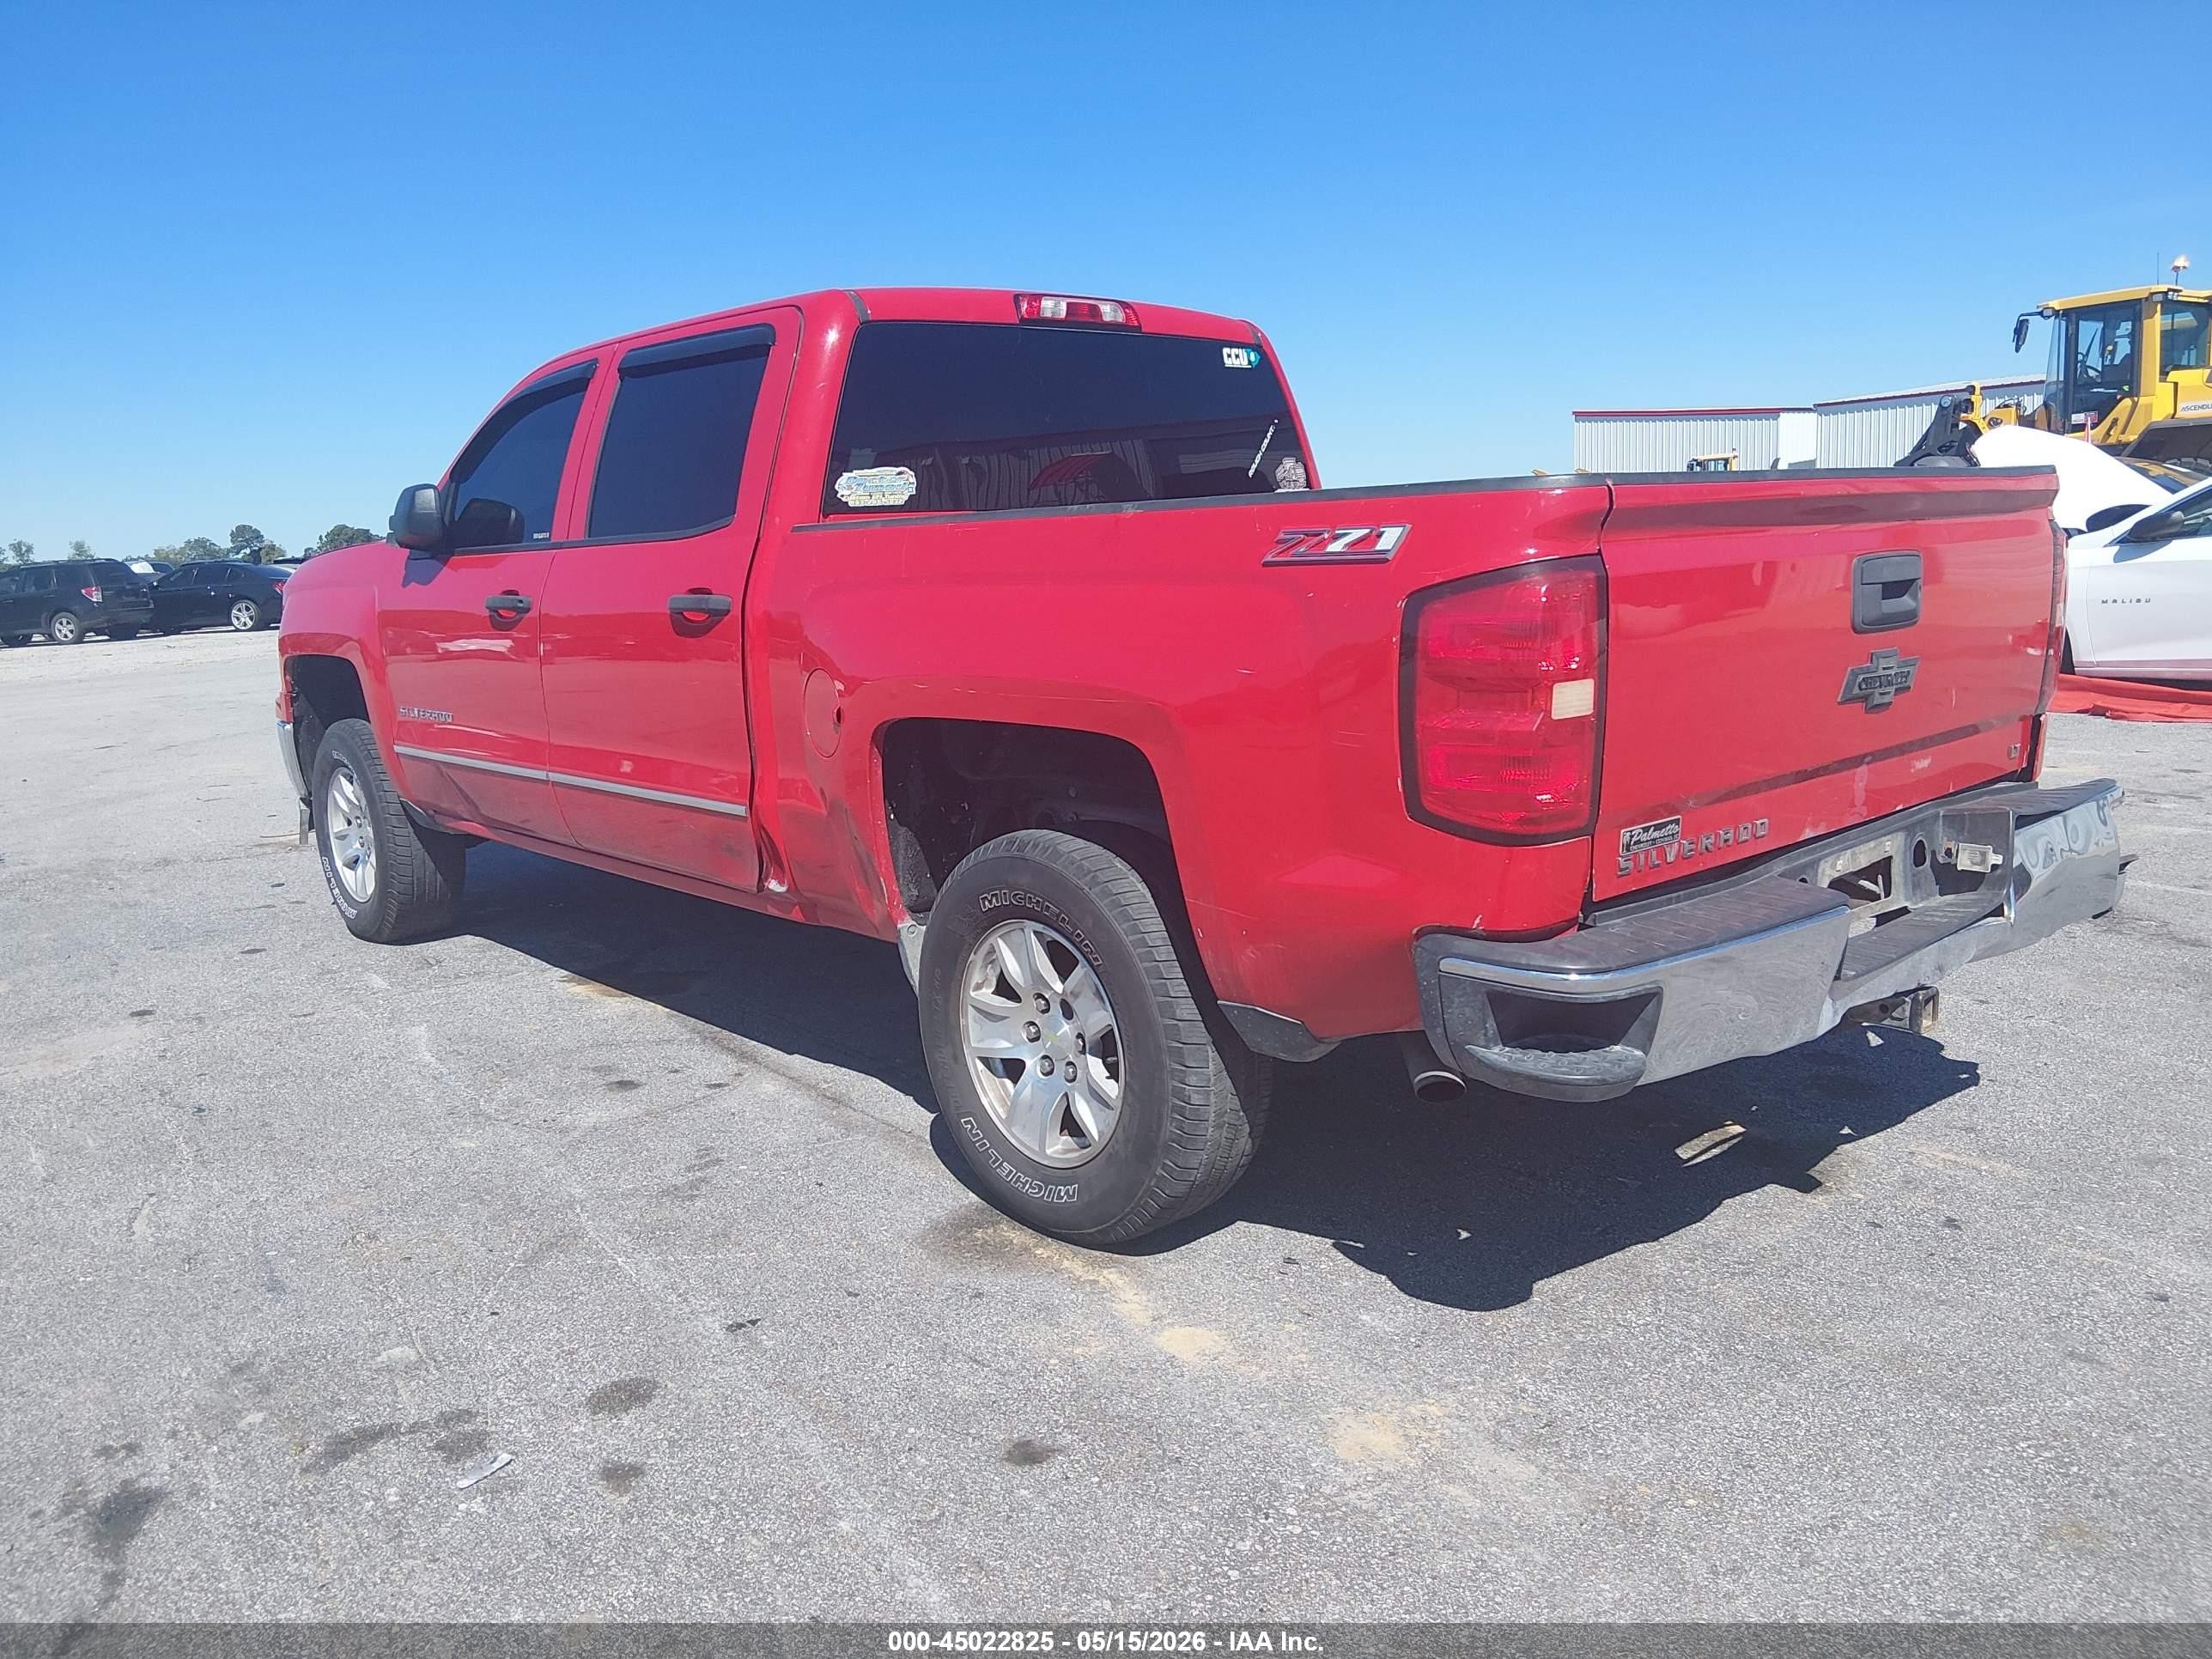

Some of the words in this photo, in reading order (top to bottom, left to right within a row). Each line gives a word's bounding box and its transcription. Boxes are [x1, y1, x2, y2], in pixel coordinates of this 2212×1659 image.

[1223, 347, 1249, 365] CCU
[1261, 522, 1413, 568] Z71
[1616, 818, 1769, 878] SILVERADO
[1630, 823, 1680, 846] Palmetto
[979, 890, 1103, 968] MICHELIN
[960, 1116, 1079, 1203] MICHELIN
